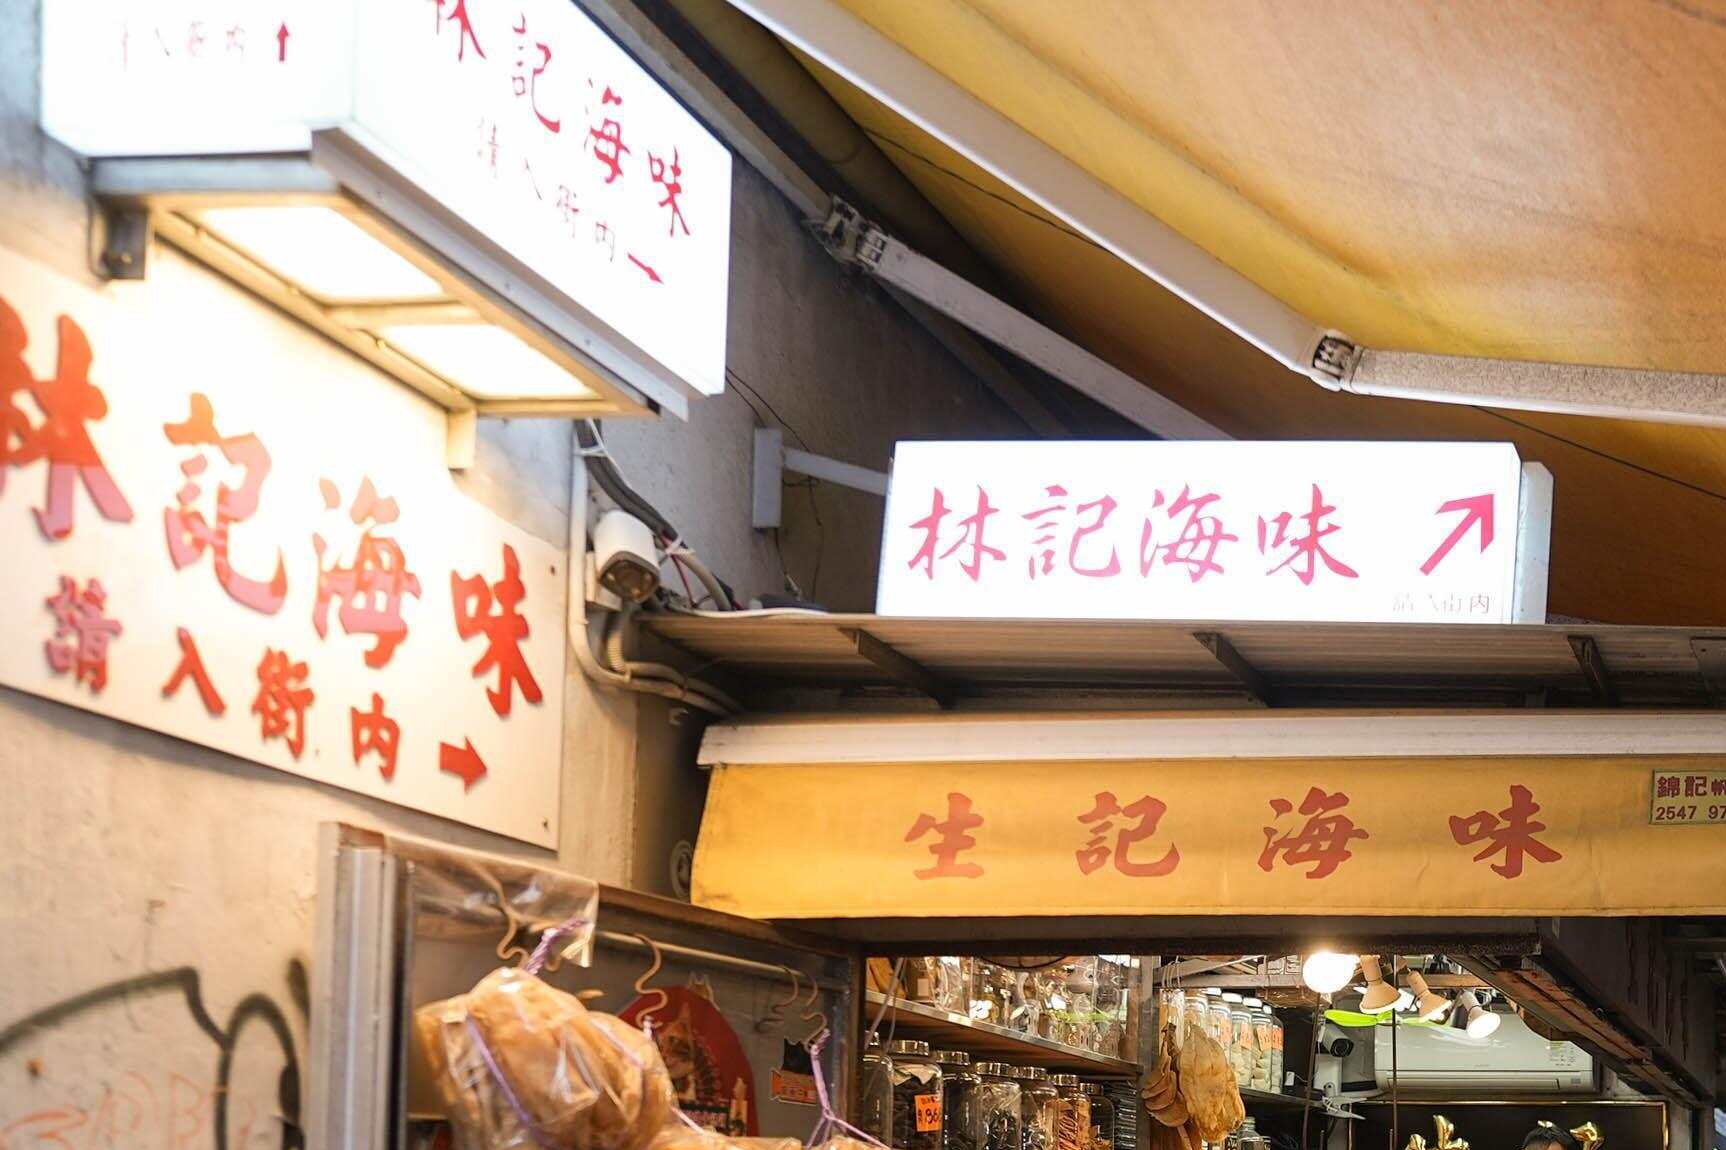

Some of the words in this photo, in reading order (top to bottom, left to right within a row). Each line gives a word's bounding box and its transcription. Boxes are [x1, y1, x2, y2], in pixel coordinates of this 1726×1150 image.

[907, 483, 1360, 586] 林記海味
[905, 784, 1563, 880] 生記海味
[1656, 805, 1697, 822] 2547
